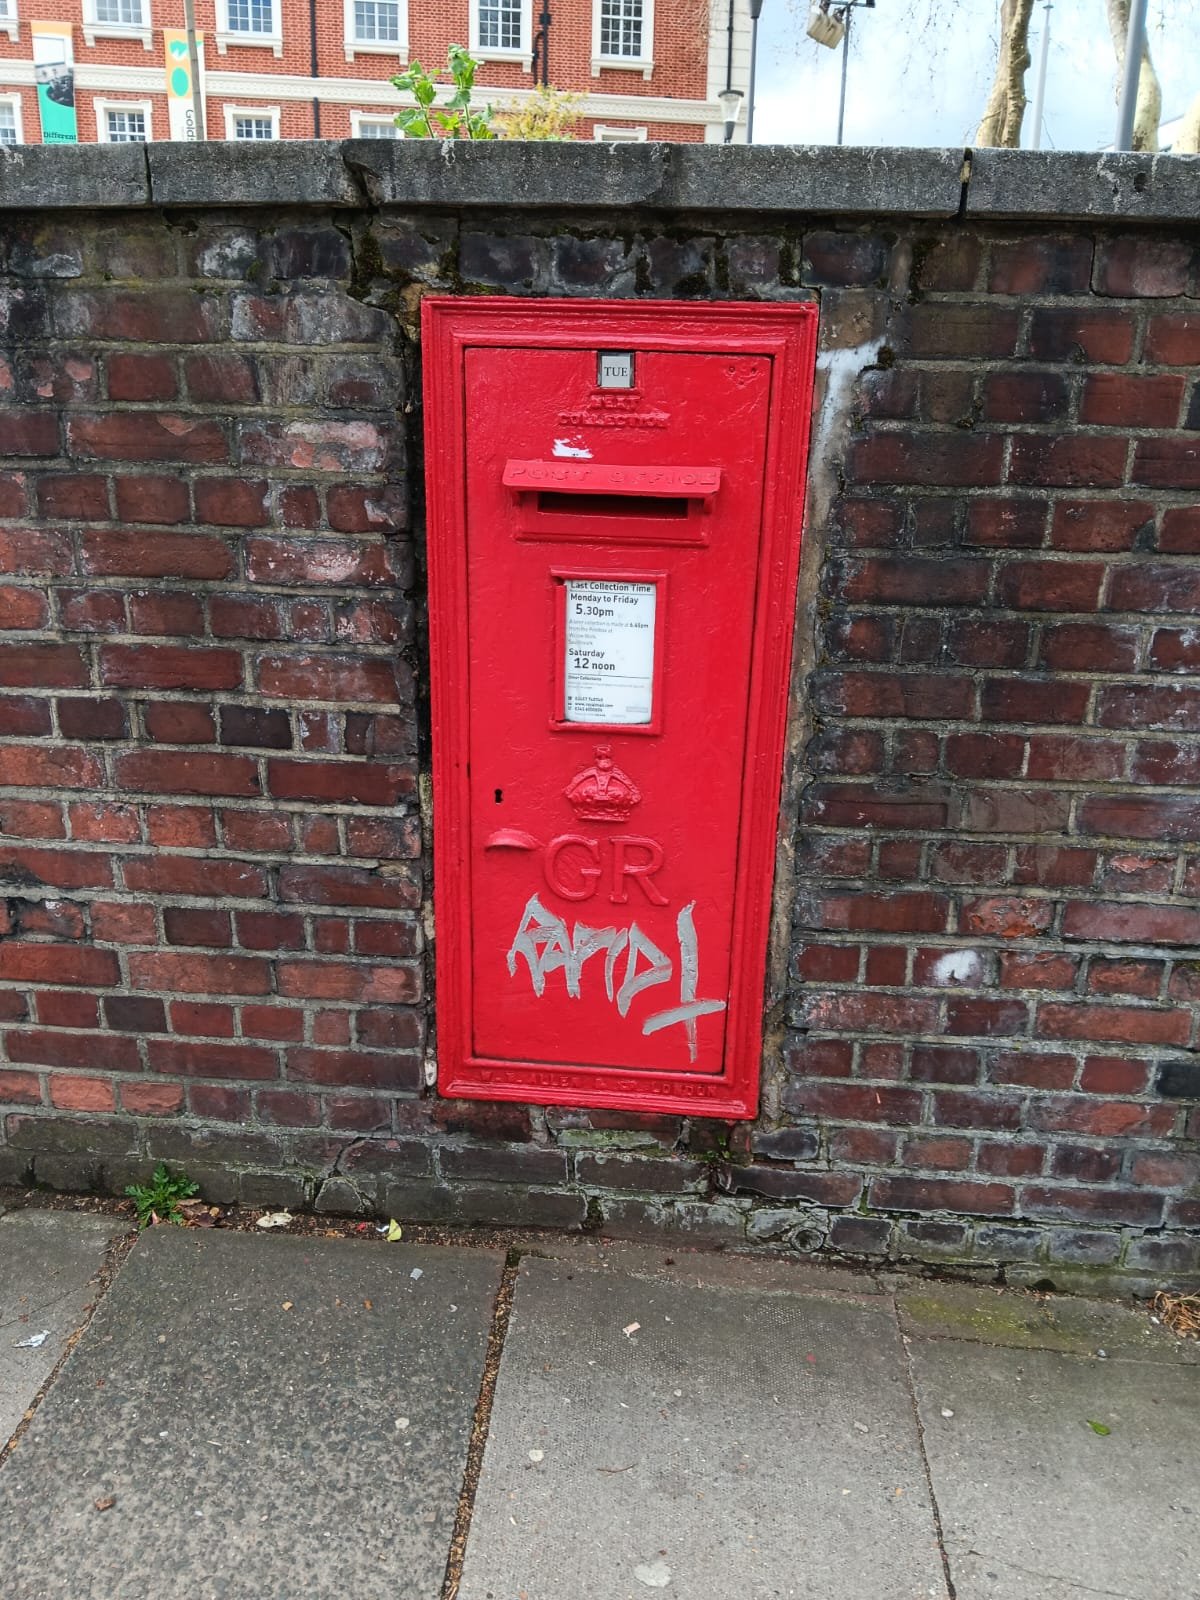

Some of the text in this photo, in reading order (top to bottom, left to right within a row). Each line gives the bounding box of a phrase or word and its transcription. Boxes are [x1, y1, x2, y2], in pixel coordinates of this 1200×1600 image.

[603, 366, 628, 377] TUE
[509, 468, 718, 486] POST OFFICE
[570, 581, 651, 592] Last Collection Time
[570, 593, 602, 603] Monday
[613, 595, 639, 605] Friday
[576, 603, 614, 618] 5.30pm
[568, 648, 605, 659] Saturday
[574, 657, 616, 671] 12 noon
[544, 834, 670, 907] GR
